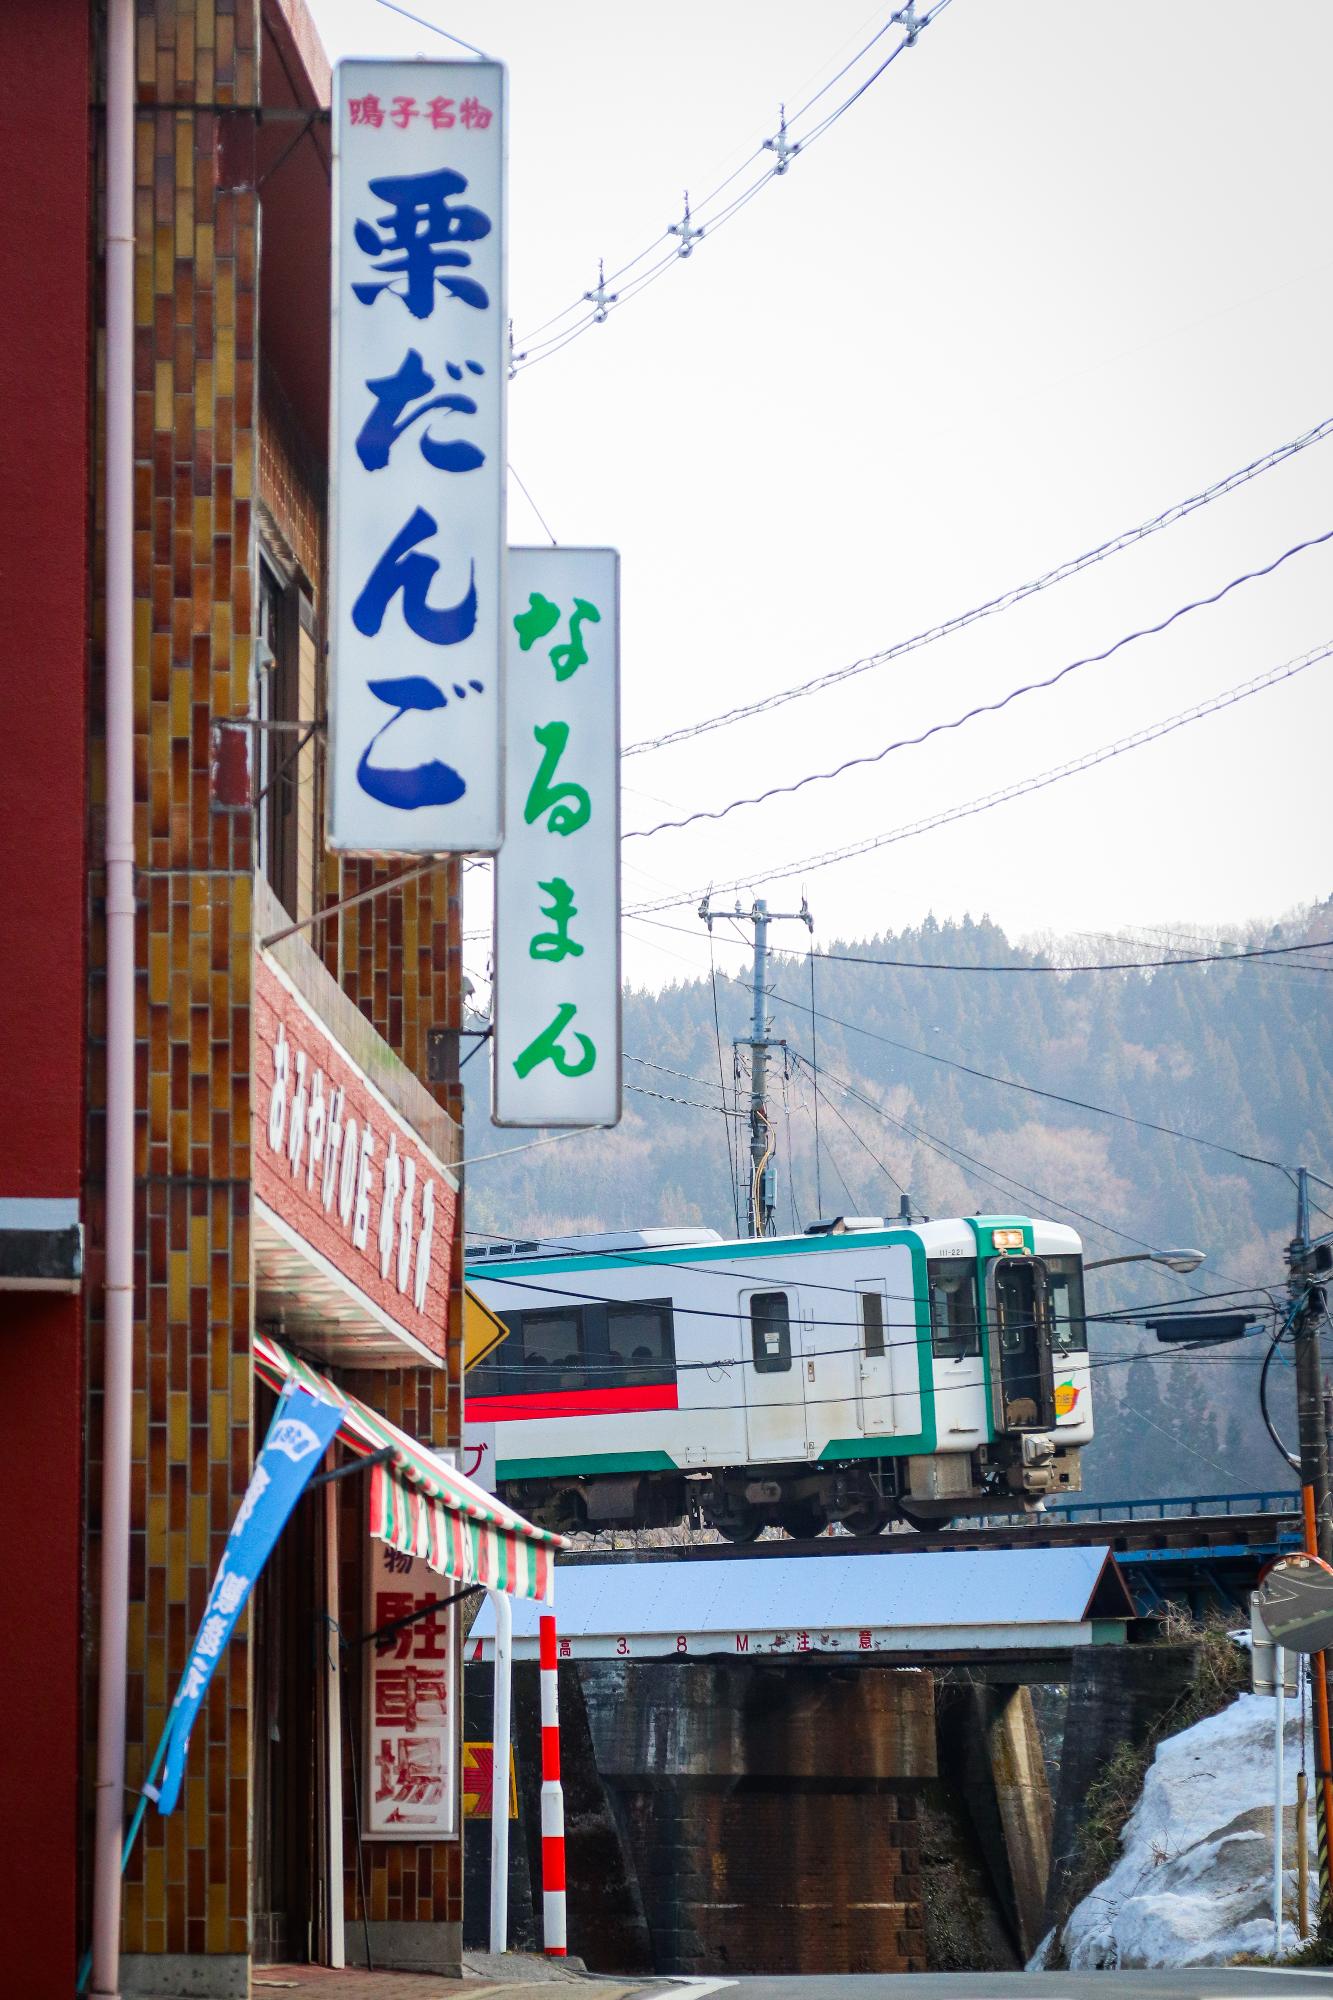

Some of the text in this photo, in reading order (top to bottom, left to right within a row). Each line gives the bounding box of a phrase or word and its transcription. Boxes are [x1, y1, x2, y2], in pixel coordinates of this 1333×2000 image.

[347, 91, 493, 130] 鳴子名物
[351, 167, 491, 810] 栗だんご
[513, 592, 601, 1080] なるまん
[267, 1021, 374, 1251] おみやげの店
[375, 1591, 448, 1804] 駐車場
